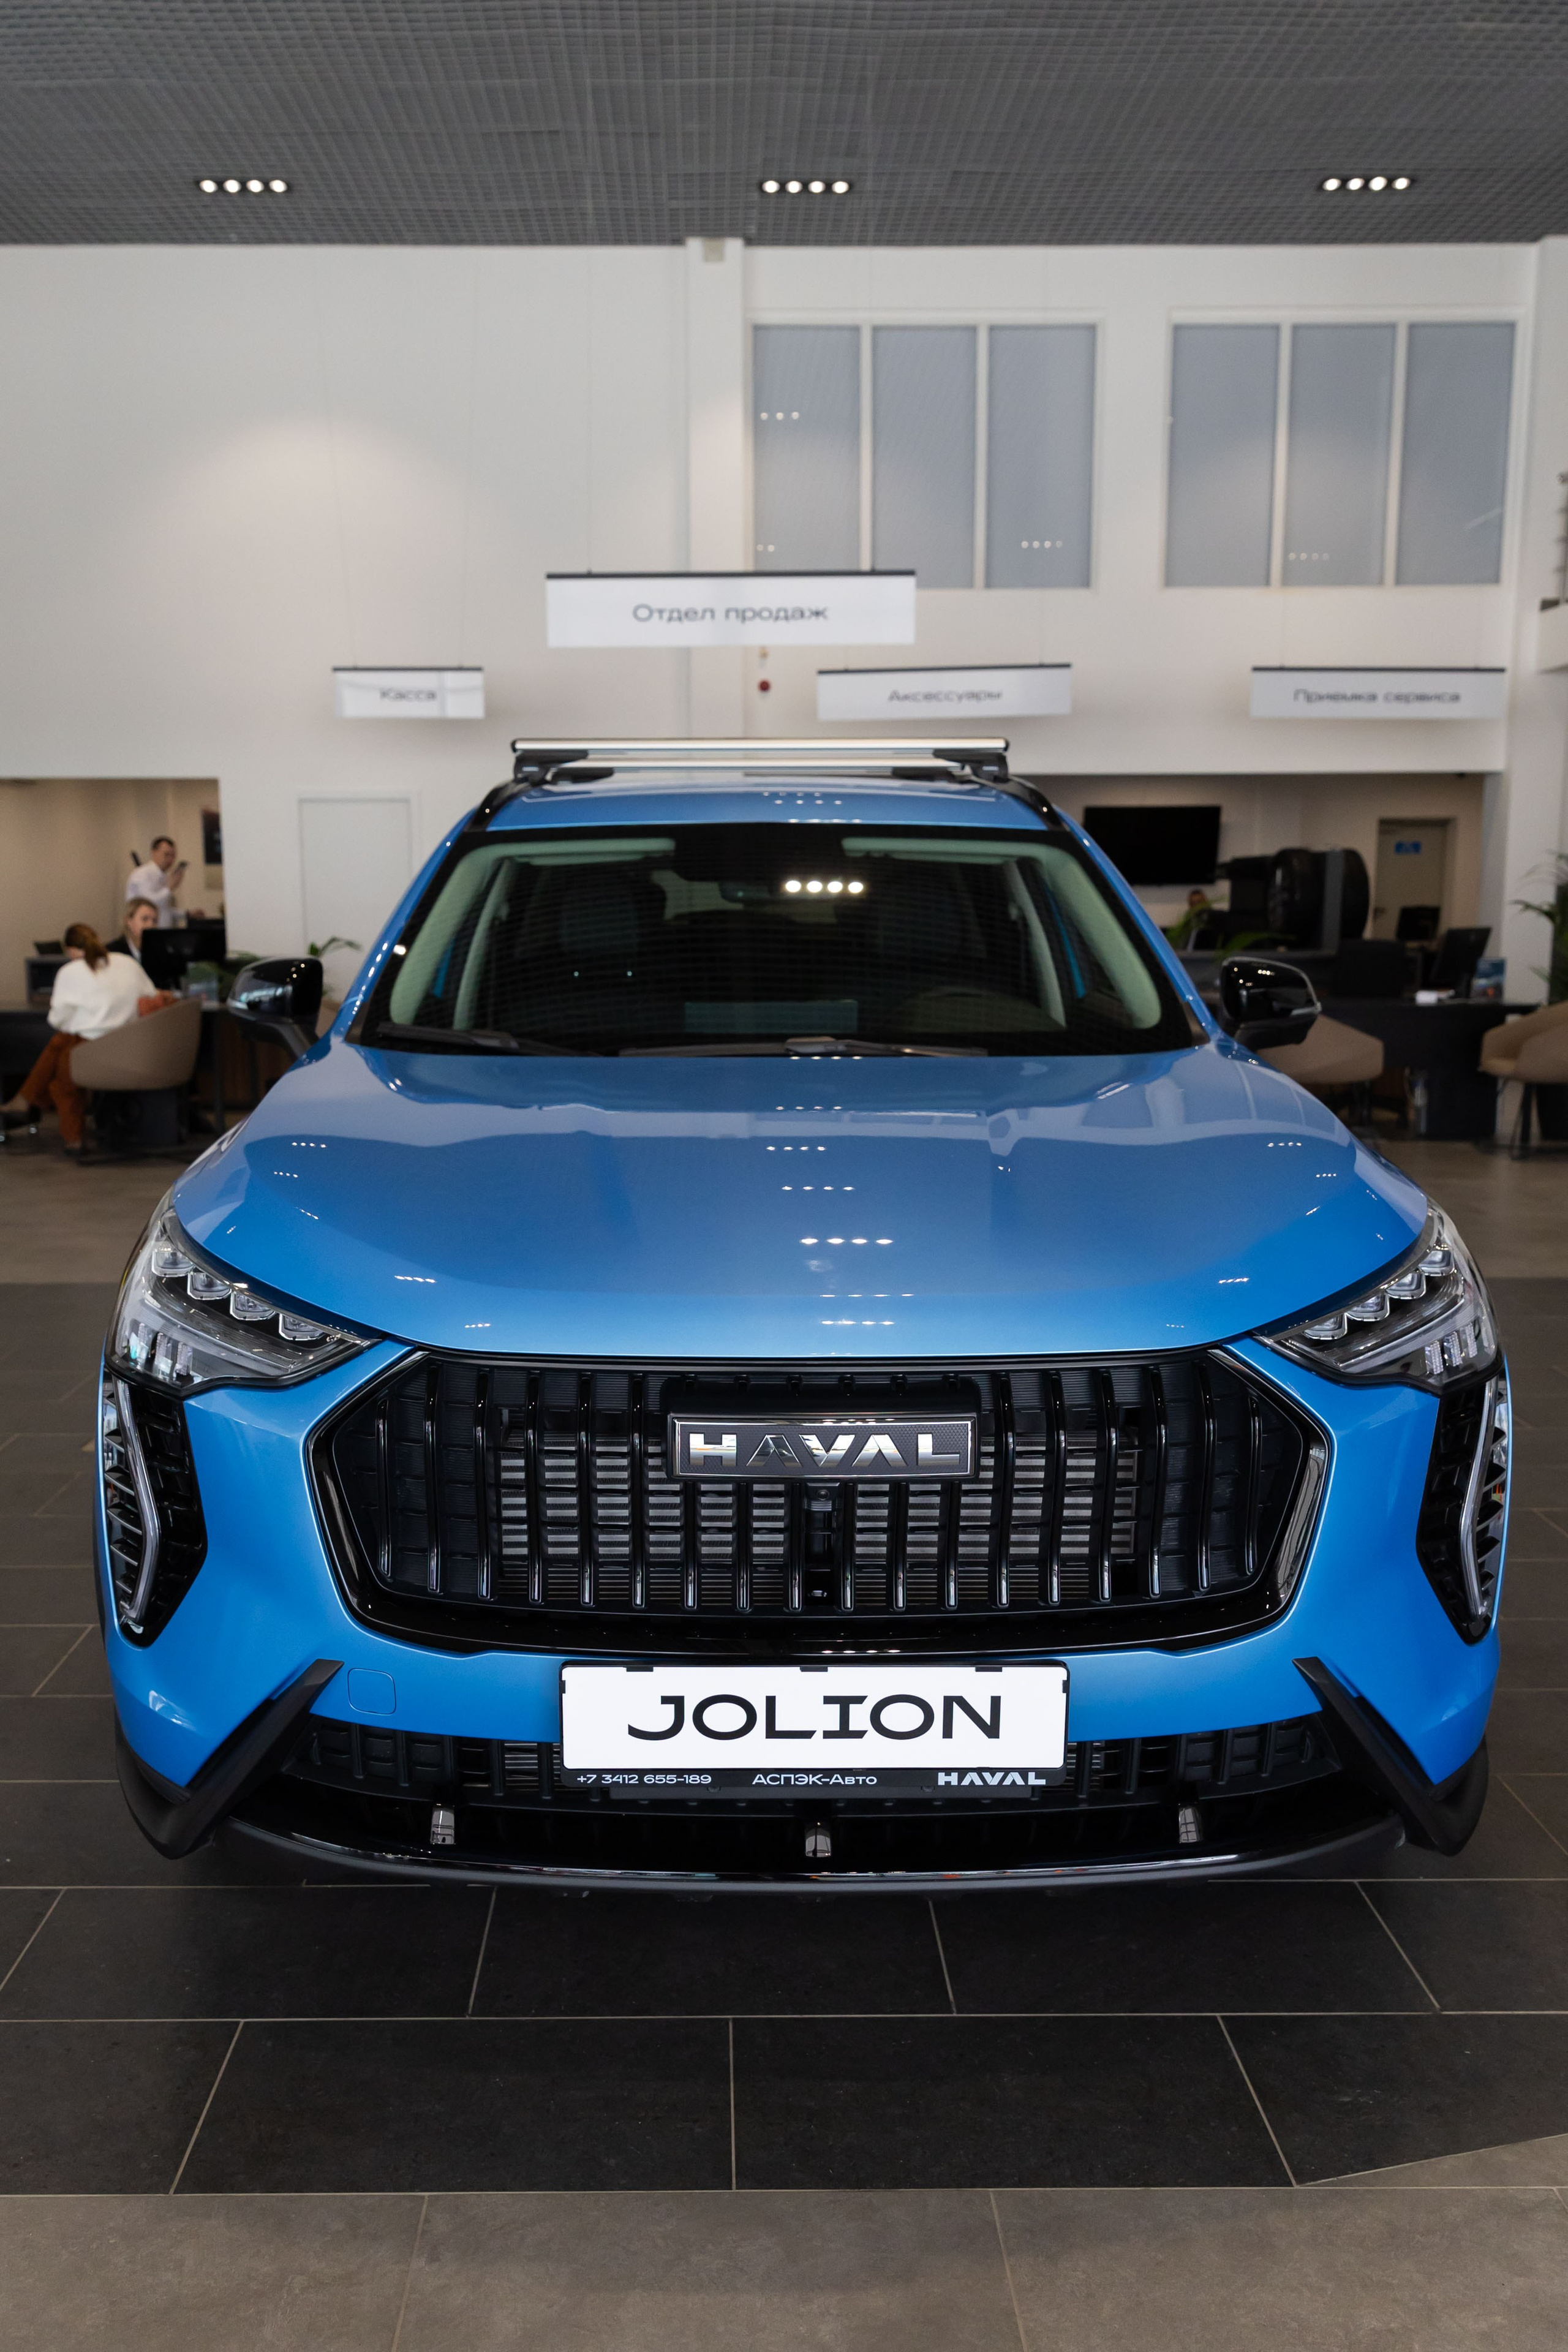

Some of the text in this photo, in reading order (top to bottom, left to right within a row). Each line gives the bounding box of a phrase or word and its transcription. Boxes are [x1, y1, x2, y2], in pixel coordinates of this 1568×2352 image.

[632, 603, 828, 625] Отдел продаж
[379, 687, 437, 702] Касса
[888, 690, 1003, 703] Аксессуары
[688, 1433, 961, 1468] HAVAL
[627, 1694, 1002, 1741] JOLION
[576, 1774, 712, 1785] +7 3412 655-189
[752, 1773, 878, 1786] АСПЭК-Авто
[937, 1771, 1047, 1786] HAVAL
